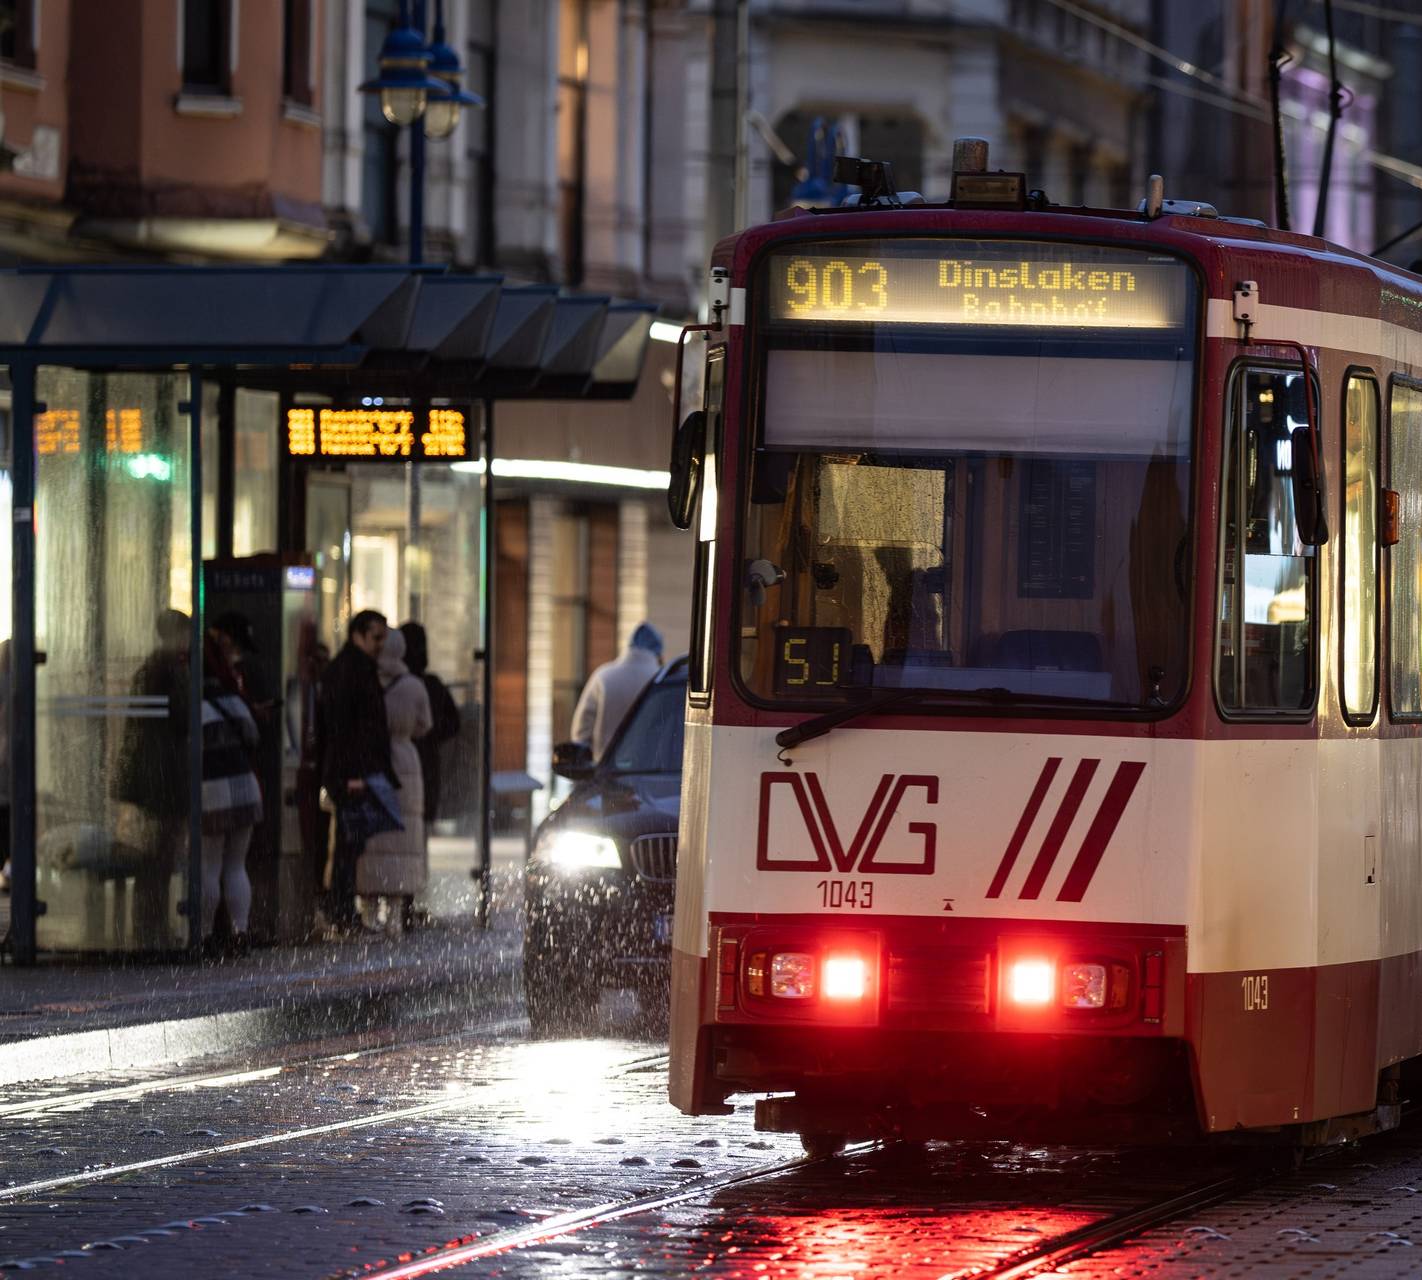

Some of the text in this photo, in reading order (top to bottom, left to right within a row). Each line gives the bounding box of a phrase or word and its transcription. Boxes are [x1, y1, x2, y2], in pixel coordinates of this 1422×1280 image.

[787, 260, 1136, 314] 903 Dinslaken
[963, 294, 1107, 322] Bahnhof
[756, 771, 939, 875] DVG
[816, 880, 874, 909] 1043
[1241, 975, 1268, 1010] 1043
